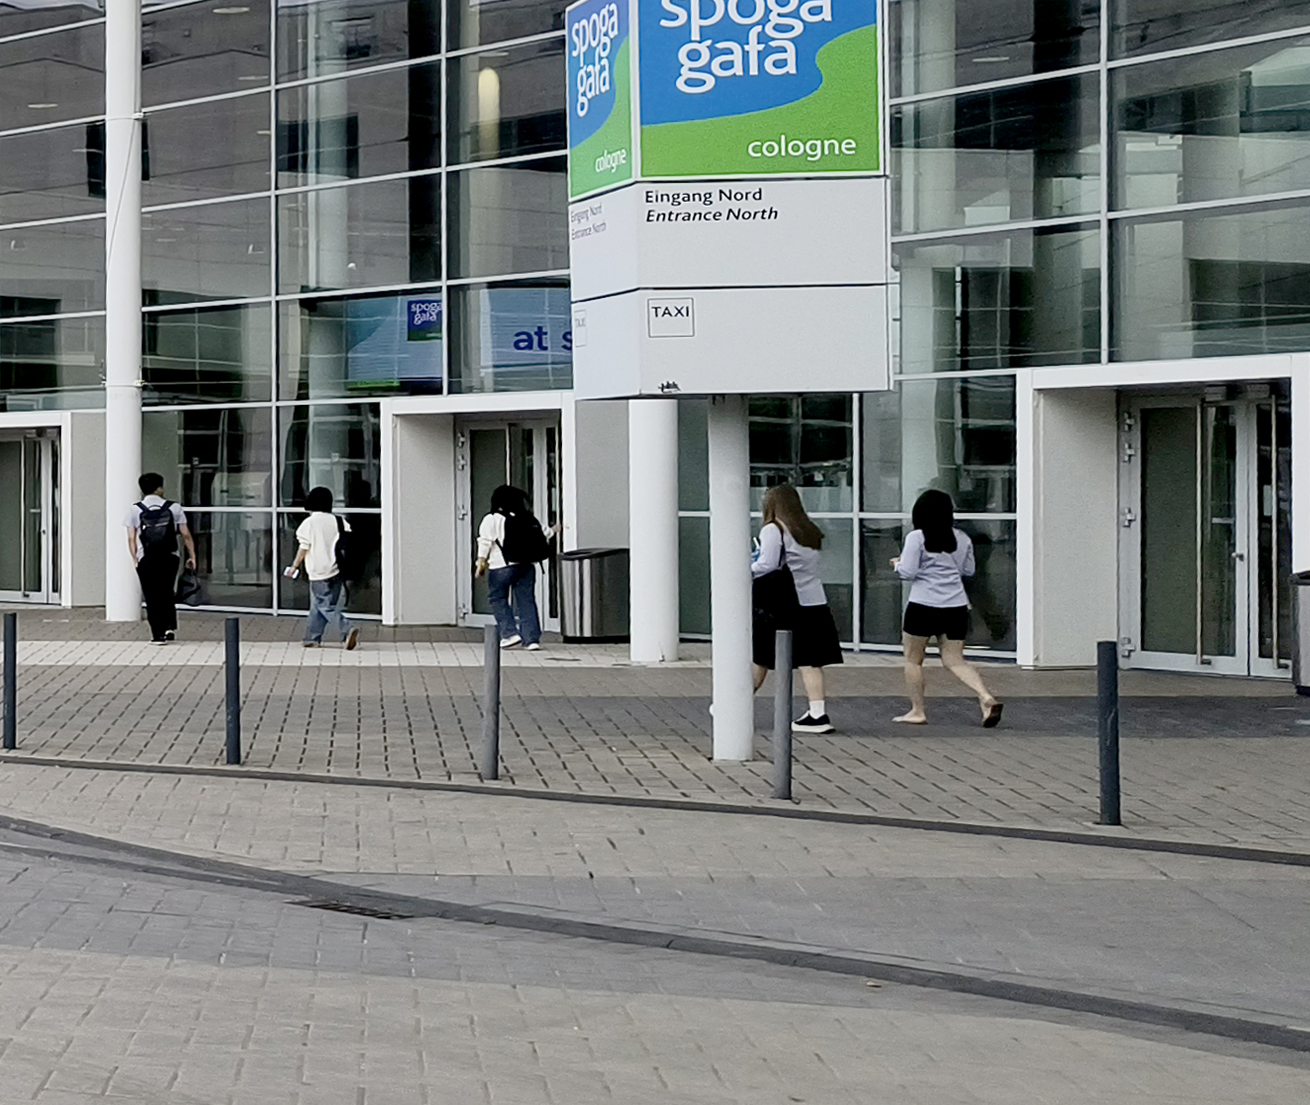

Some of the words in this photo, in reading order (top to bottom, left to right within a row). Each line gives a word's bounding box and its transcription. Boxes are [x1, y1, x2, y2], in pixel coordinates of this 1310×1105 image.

[570, 1, 619, 58] spoga
[675, 27, 798, 93] gafa
[576, 52, 611, 118] gafa
[594, 147, 627, 174] cologne
[747, 134, 857, 161] cologne
[645, 189, 713, 206] Eingang
[718, 187, 763, 202] Nord
[645, 209, 723, 223] Entrance
[726, 206, 779, 221] North
[651, 305, 690, 318] TAXI
[512, 325, 549, 351] at
